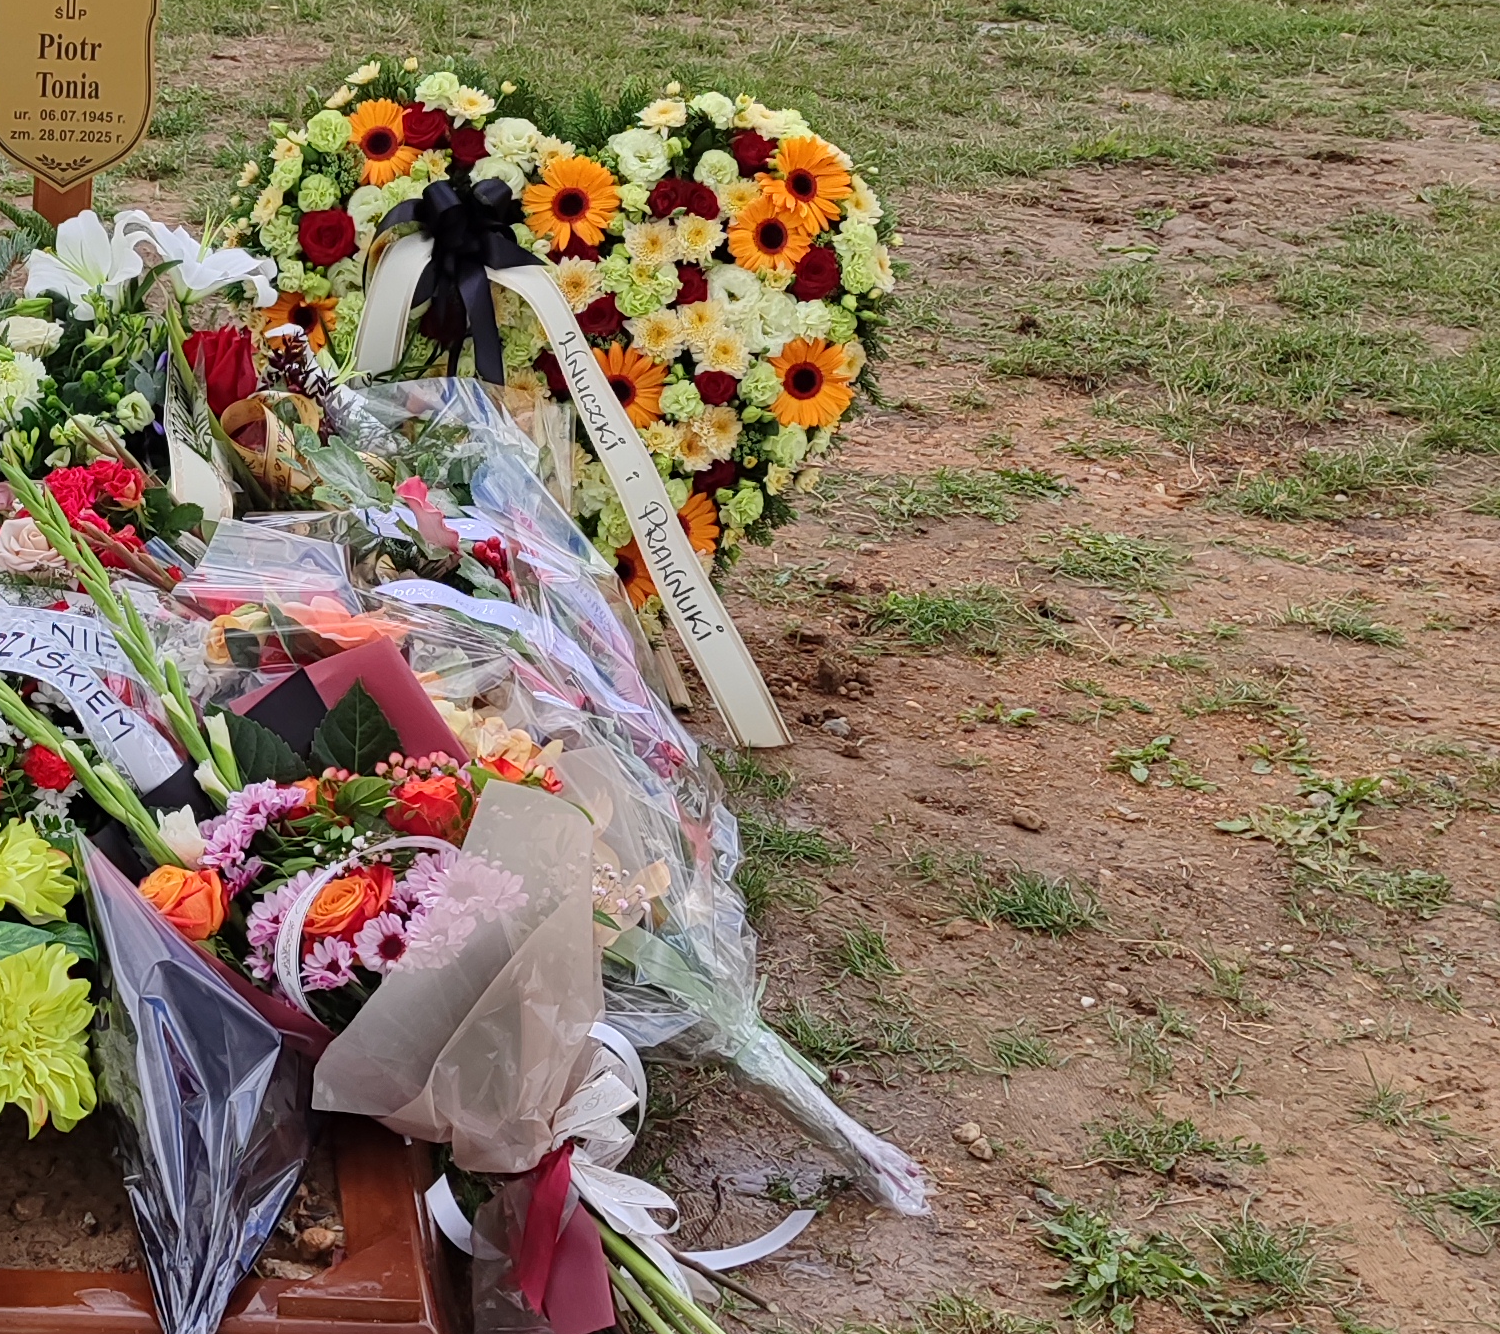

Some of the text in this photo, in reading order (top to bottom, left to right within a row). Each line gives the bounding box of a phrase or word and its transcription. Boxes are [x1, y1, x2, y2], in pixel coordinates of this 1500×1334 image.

[54, 6, 87, 20] Ś P
[37, 33, 102, 61] Piotr
[36, 72, 100, 100] Tonia
[14, 109, 126, 124] ur. 06.07.1945 r.
[10, 129, 125, 144] zm. 28.07.2025 r.
